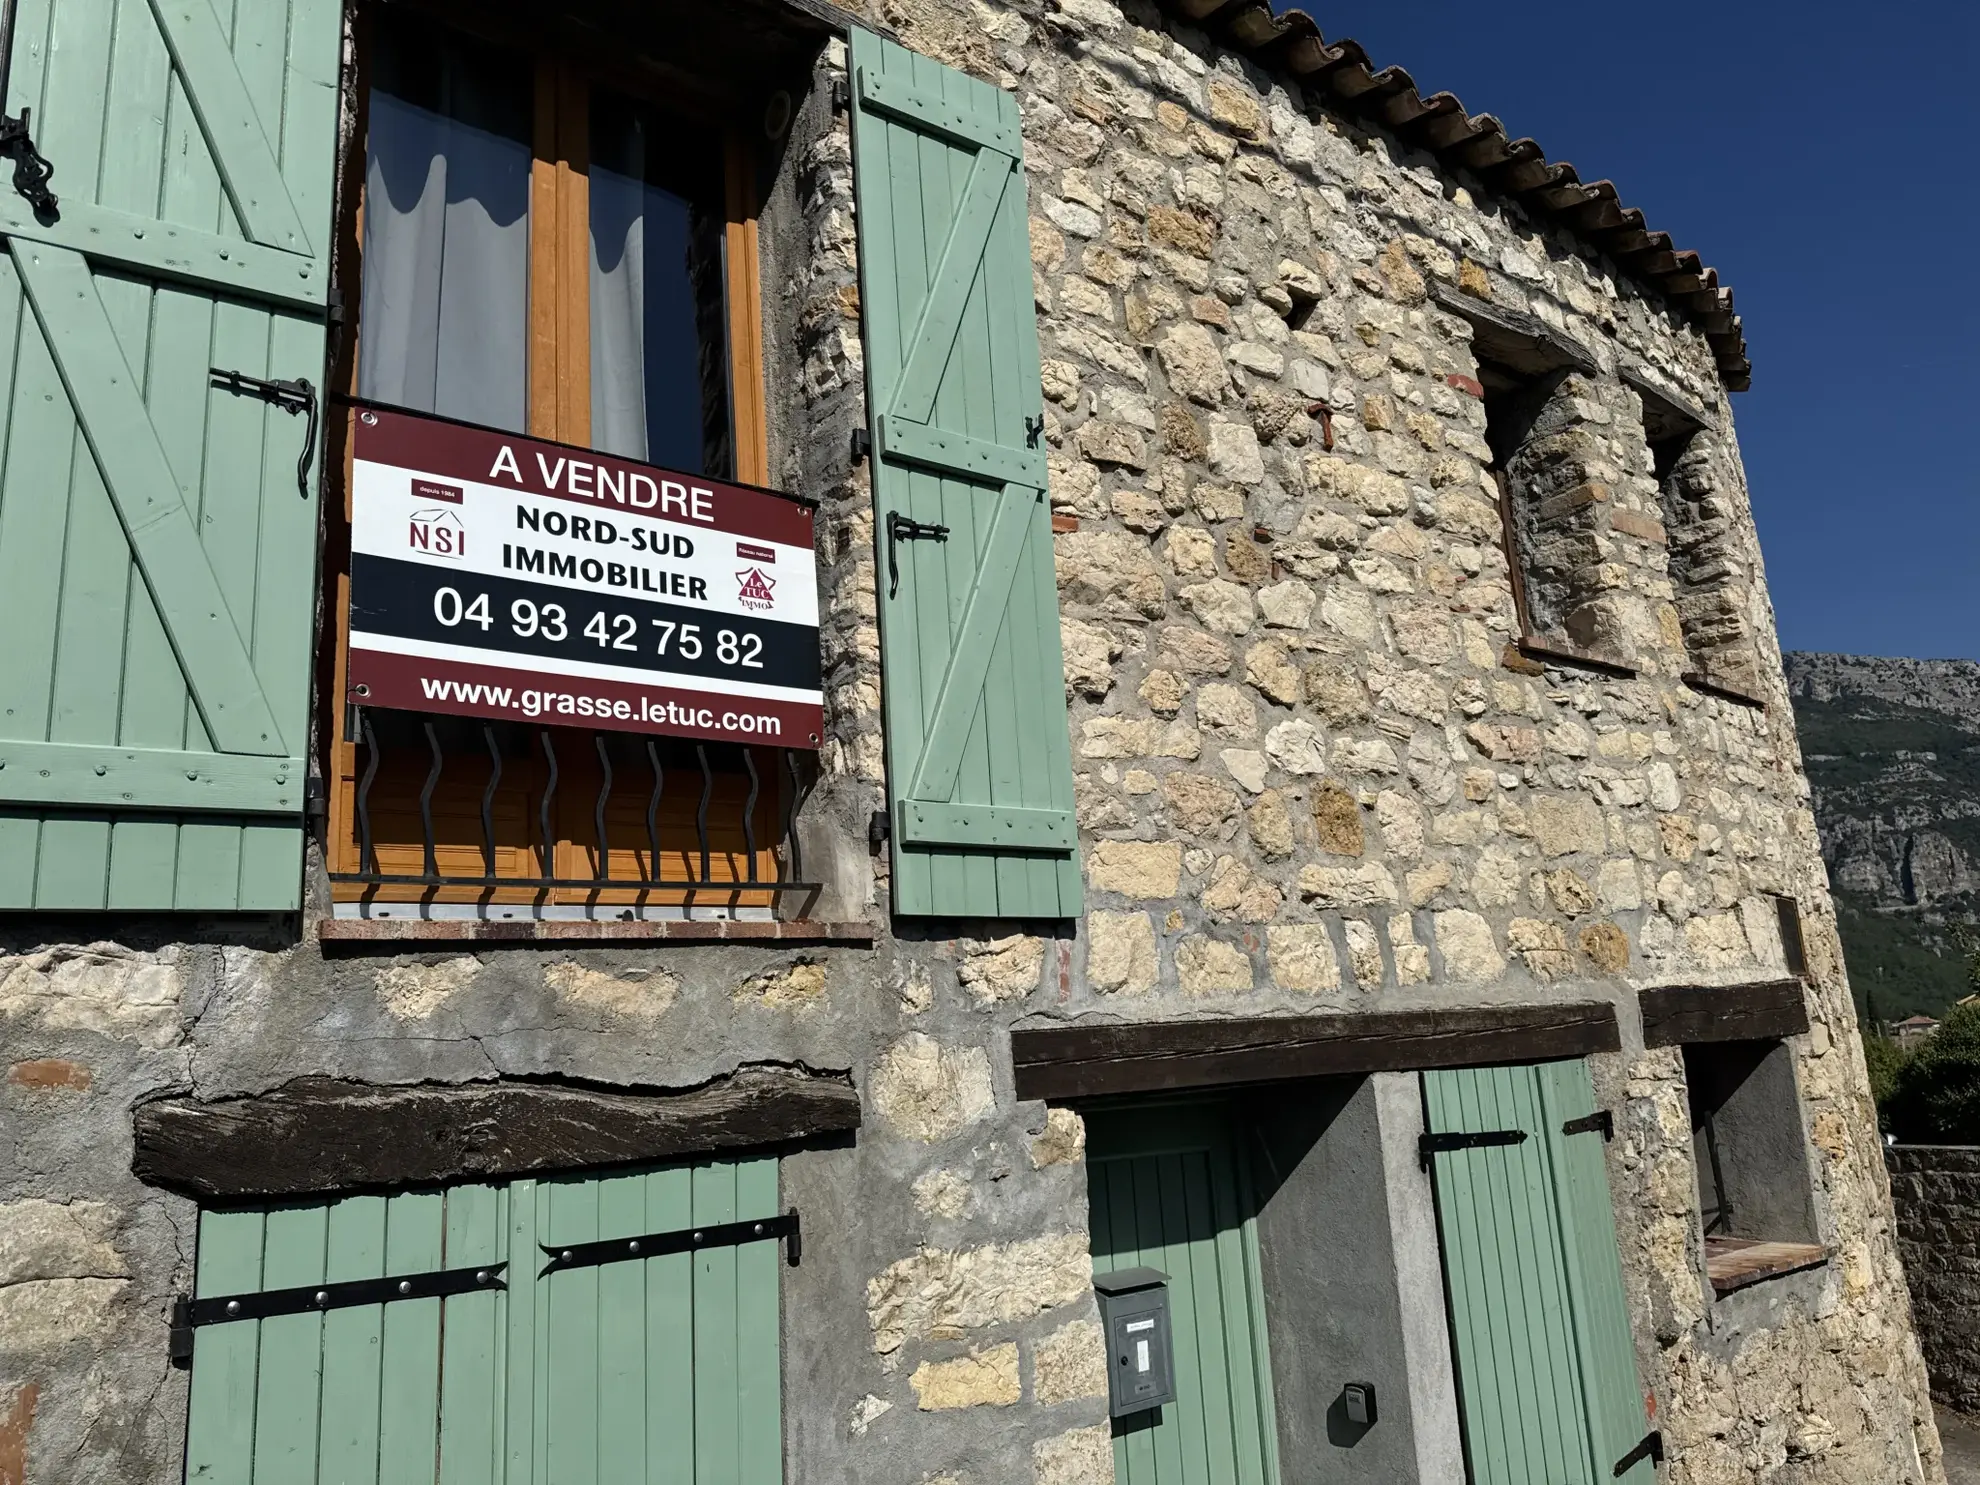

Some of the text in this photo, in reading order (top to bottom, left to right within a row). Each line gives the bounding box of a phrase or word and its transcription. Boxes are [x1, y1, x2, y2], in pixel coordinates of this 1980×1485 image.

[420, 486, 439, 494] depuis
[489, 445, 715, 523] A VENDRE
[410, 522, 464, 556] NSI
[516, 505, 695, 559] NORD-SUD
[503, 544, 707, 601] IMMOBILIER
[745, 587, 769, 598] TUC
[750, 578, 762, 587] Le
[433, 586, 764, 668] 04 93 42 75 82
[420, 678, 781, 735] www.grasse.letuc.com
